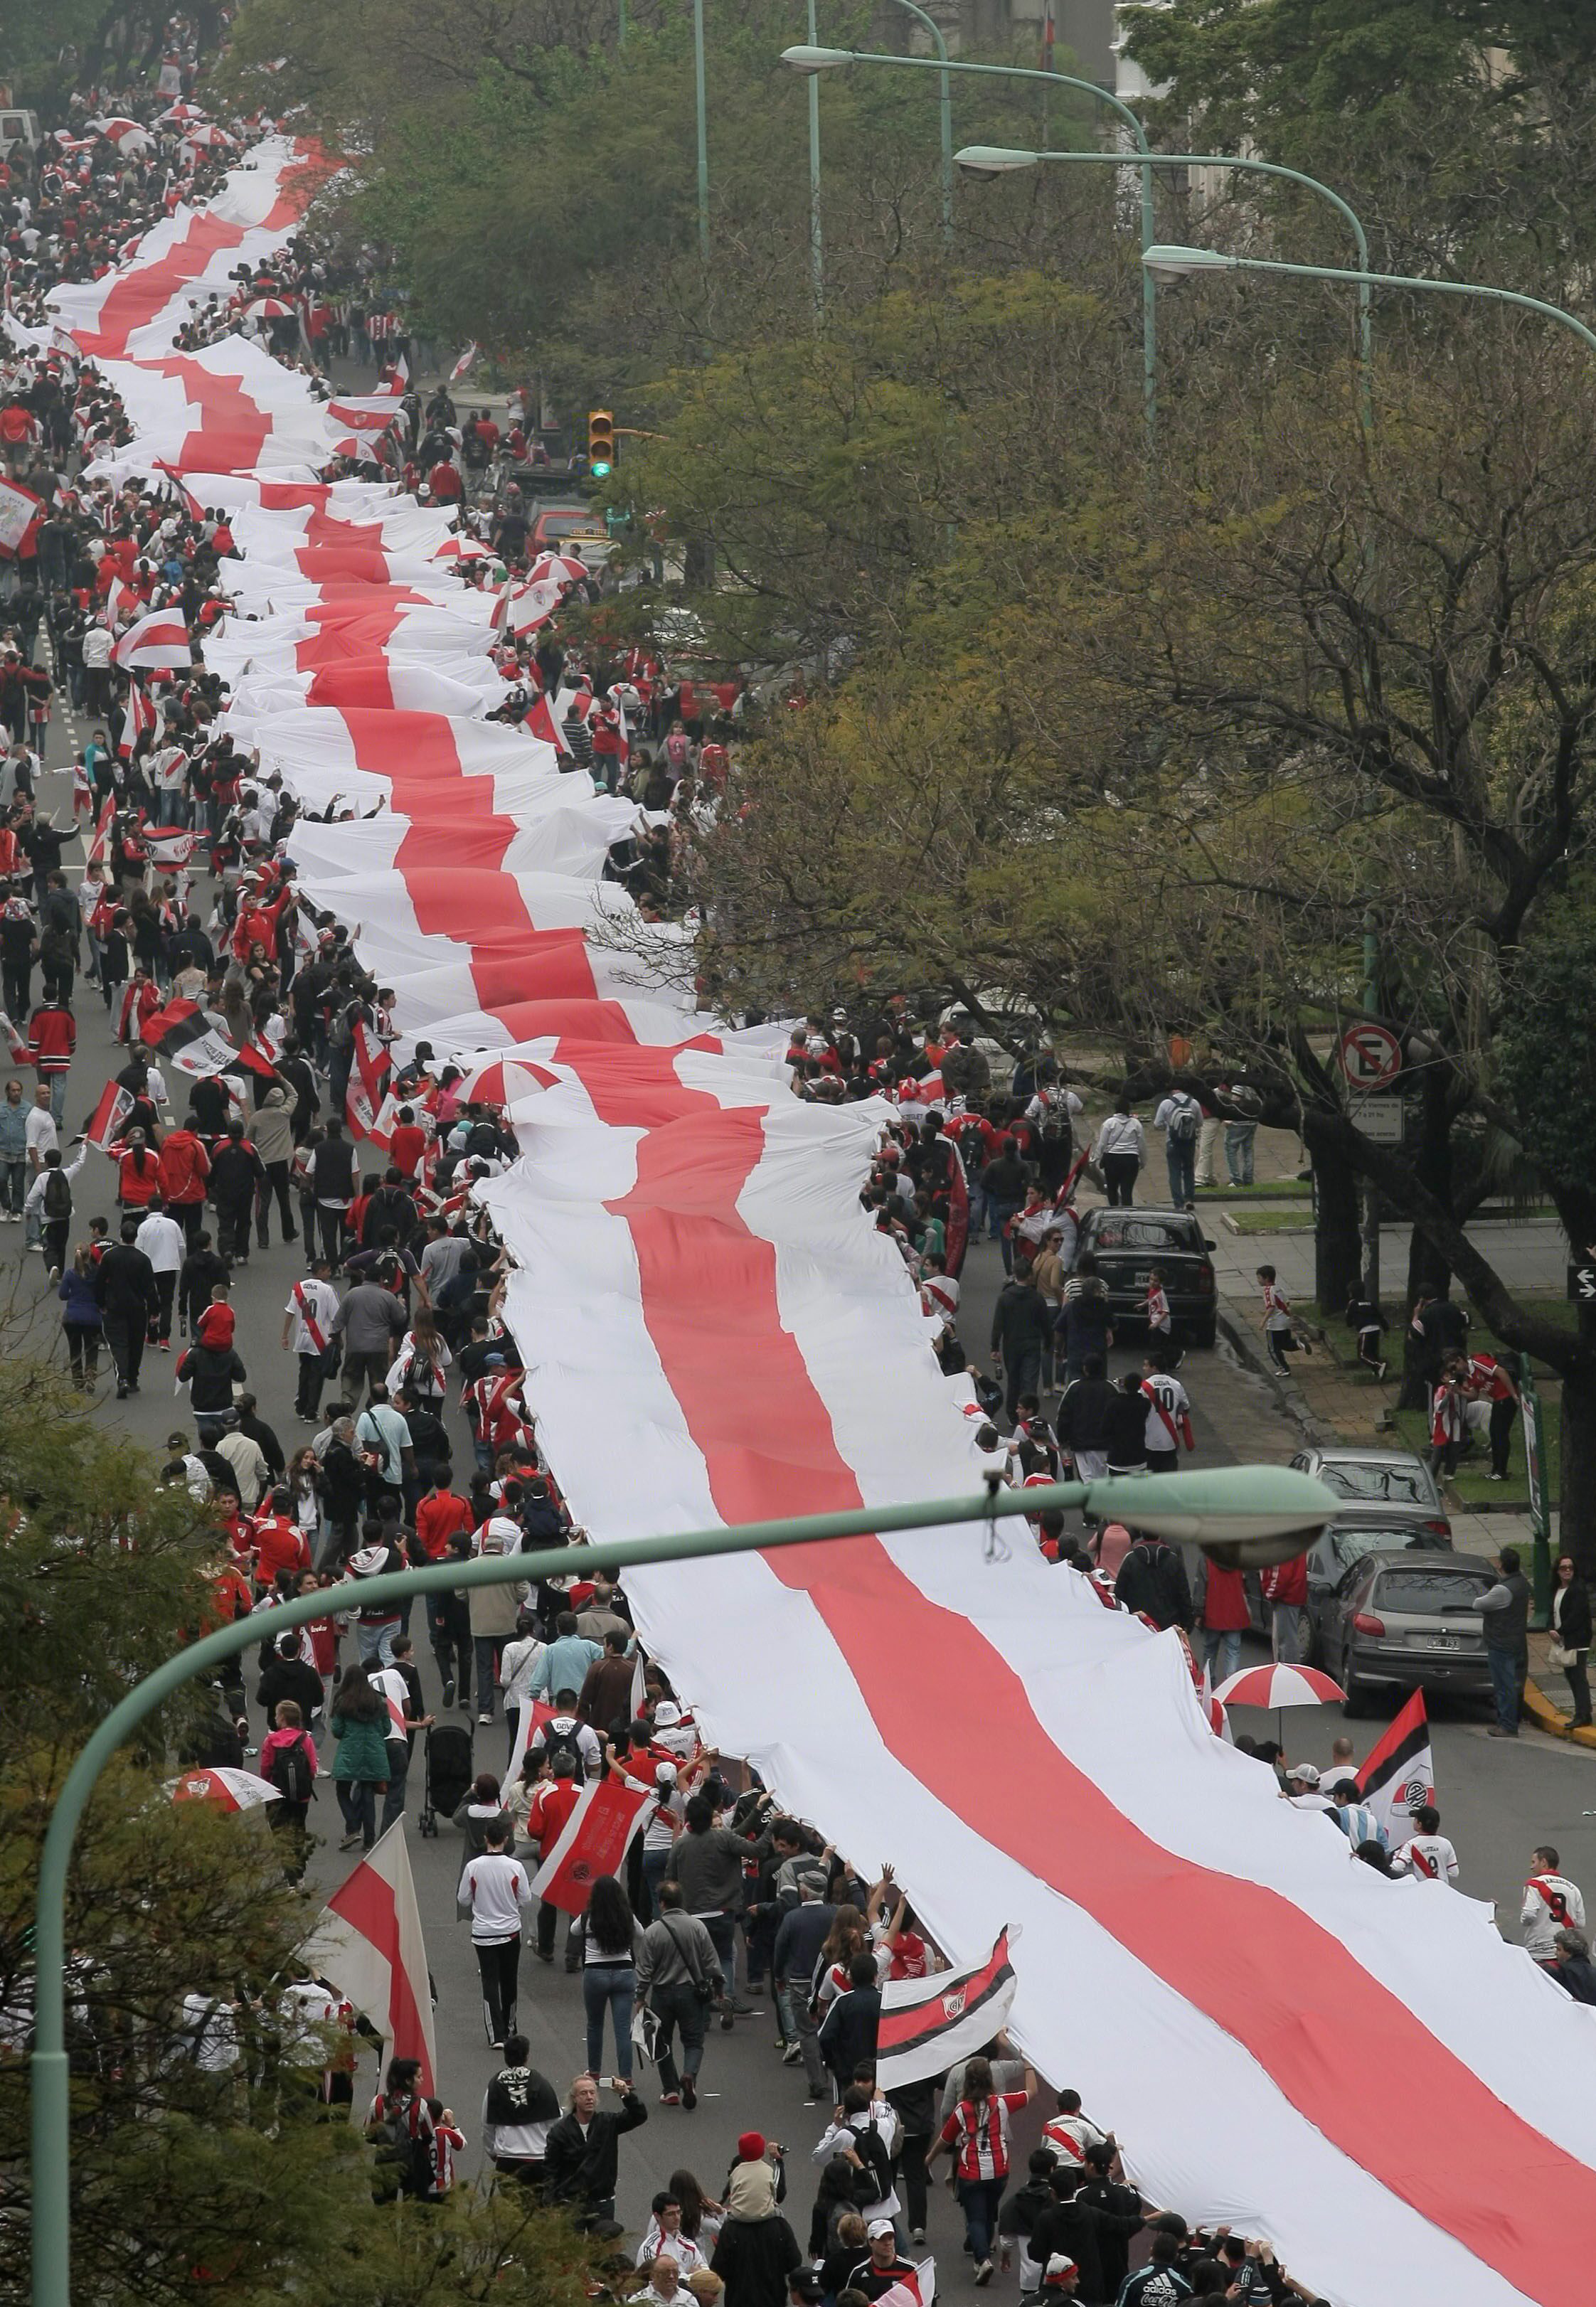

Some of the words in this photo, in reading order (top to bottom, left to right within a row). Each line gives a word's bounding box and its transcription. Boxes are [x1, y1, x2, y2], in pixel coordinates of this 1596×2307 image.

[1359, 1040, 1382, 1075] E
[302, 1297, 317, 1320] 10
[1155, 1387, 1174, 1412] 10
[1428, 1855, 1438, 1875] 9
[1549, 1892, 1566, 1922] 9
[1143, 2284, 1177, 2296] adidas
